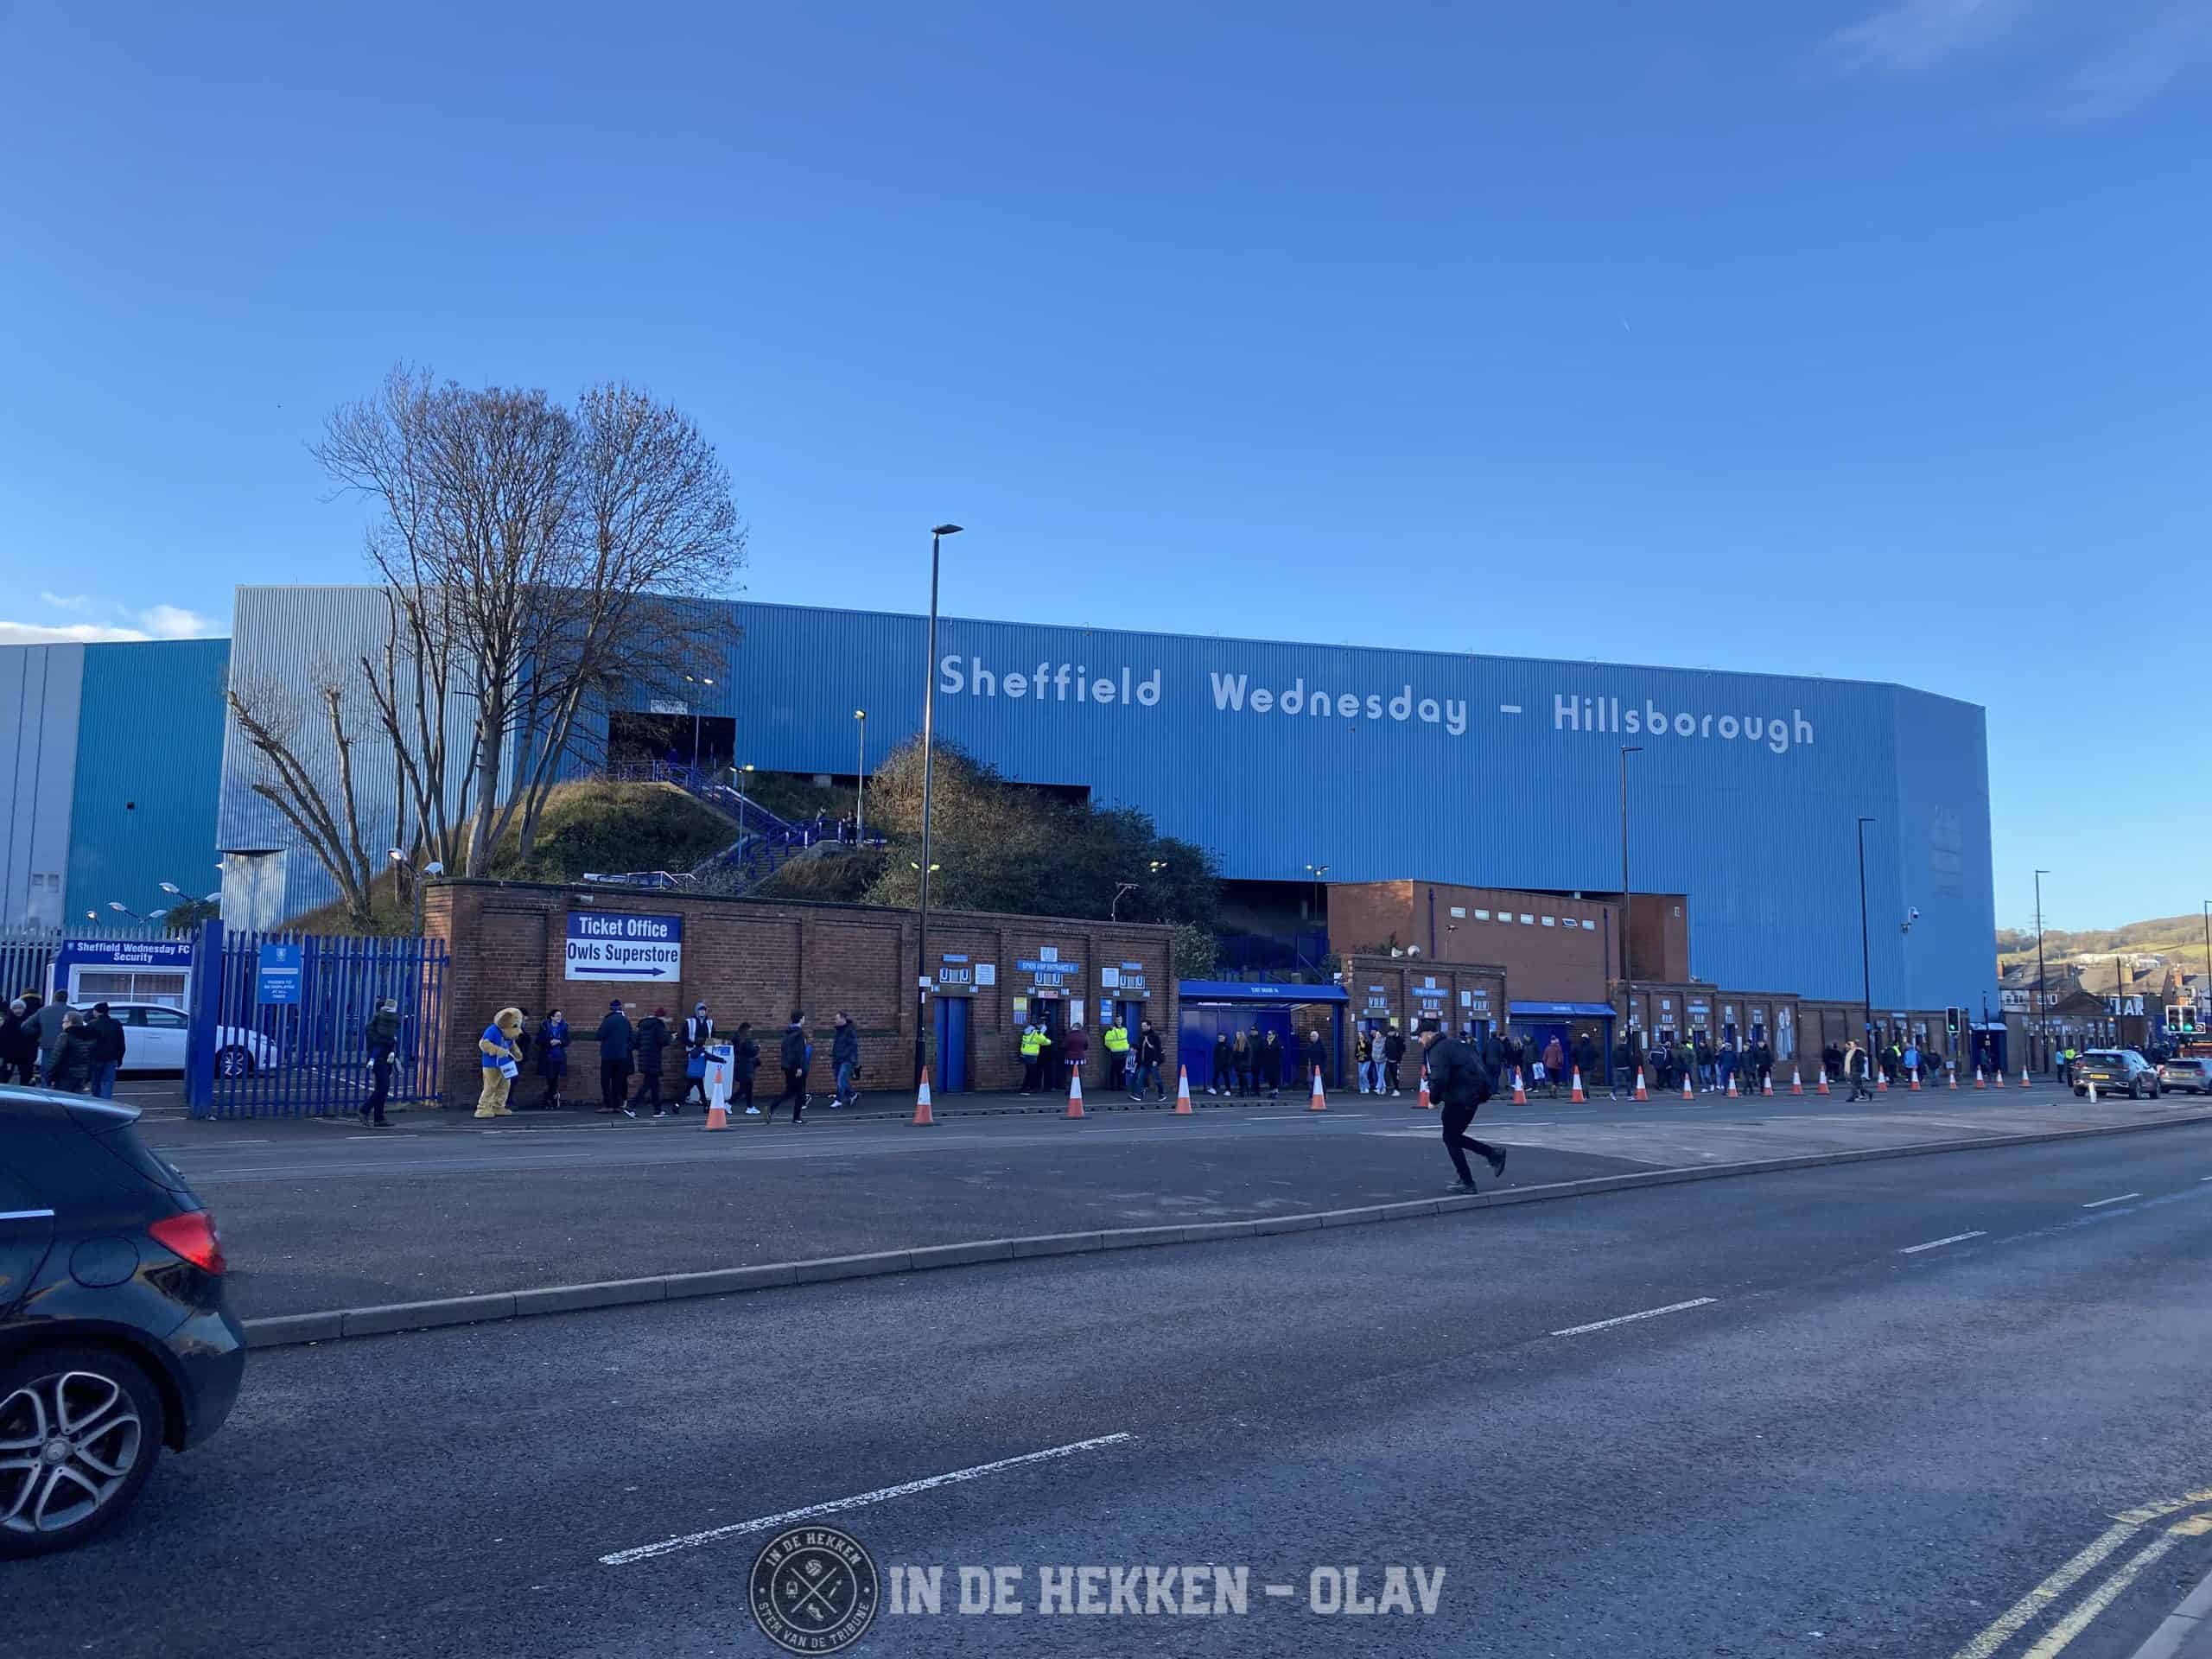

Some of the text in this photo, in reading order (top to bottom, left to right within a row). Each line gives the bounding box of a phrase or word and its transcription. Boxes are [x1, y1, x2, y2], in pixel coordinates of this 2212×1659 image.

[940, 655, 1814, 753] Sheffield Wednesday - Hillsborough
[579, 916, 668, 938] Ticket Office
[77, 942, 190, 955] Sheffield Wednesday FC
[113, 952, 153, 963] Security
[567, 942, 678, 965] Owls Superstore
